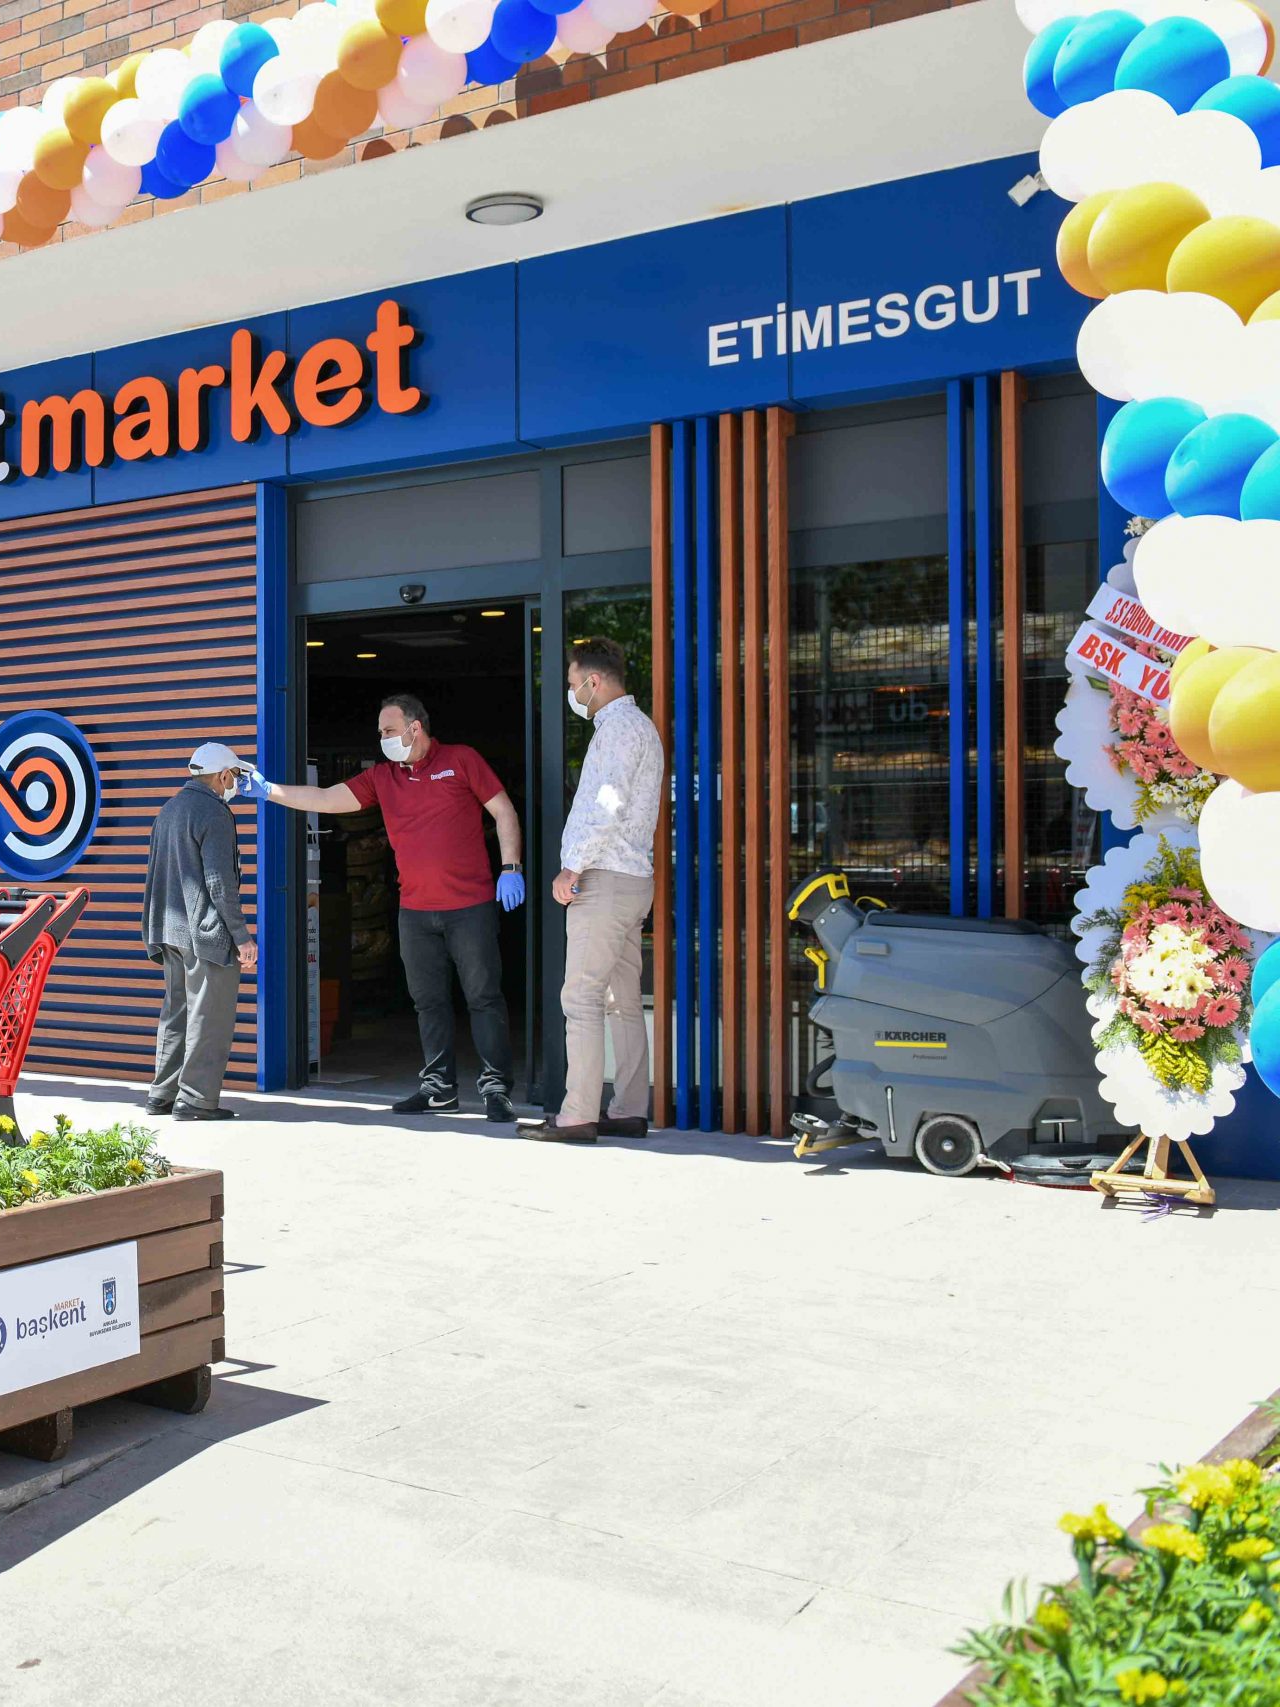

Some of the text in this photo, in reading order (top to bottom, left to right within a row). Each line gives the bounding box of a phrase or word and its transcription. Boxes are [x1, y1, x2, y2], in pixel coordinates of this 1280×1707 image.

[709, 268, 1041, 366] ETİMESGUT
[21, 300, 420, 476] market
[884, 1031, 946, 1042] KÄRCHER
[16, 1300, 86, 1340] başkent
[54, 1297, 80, 1312] MARKET
